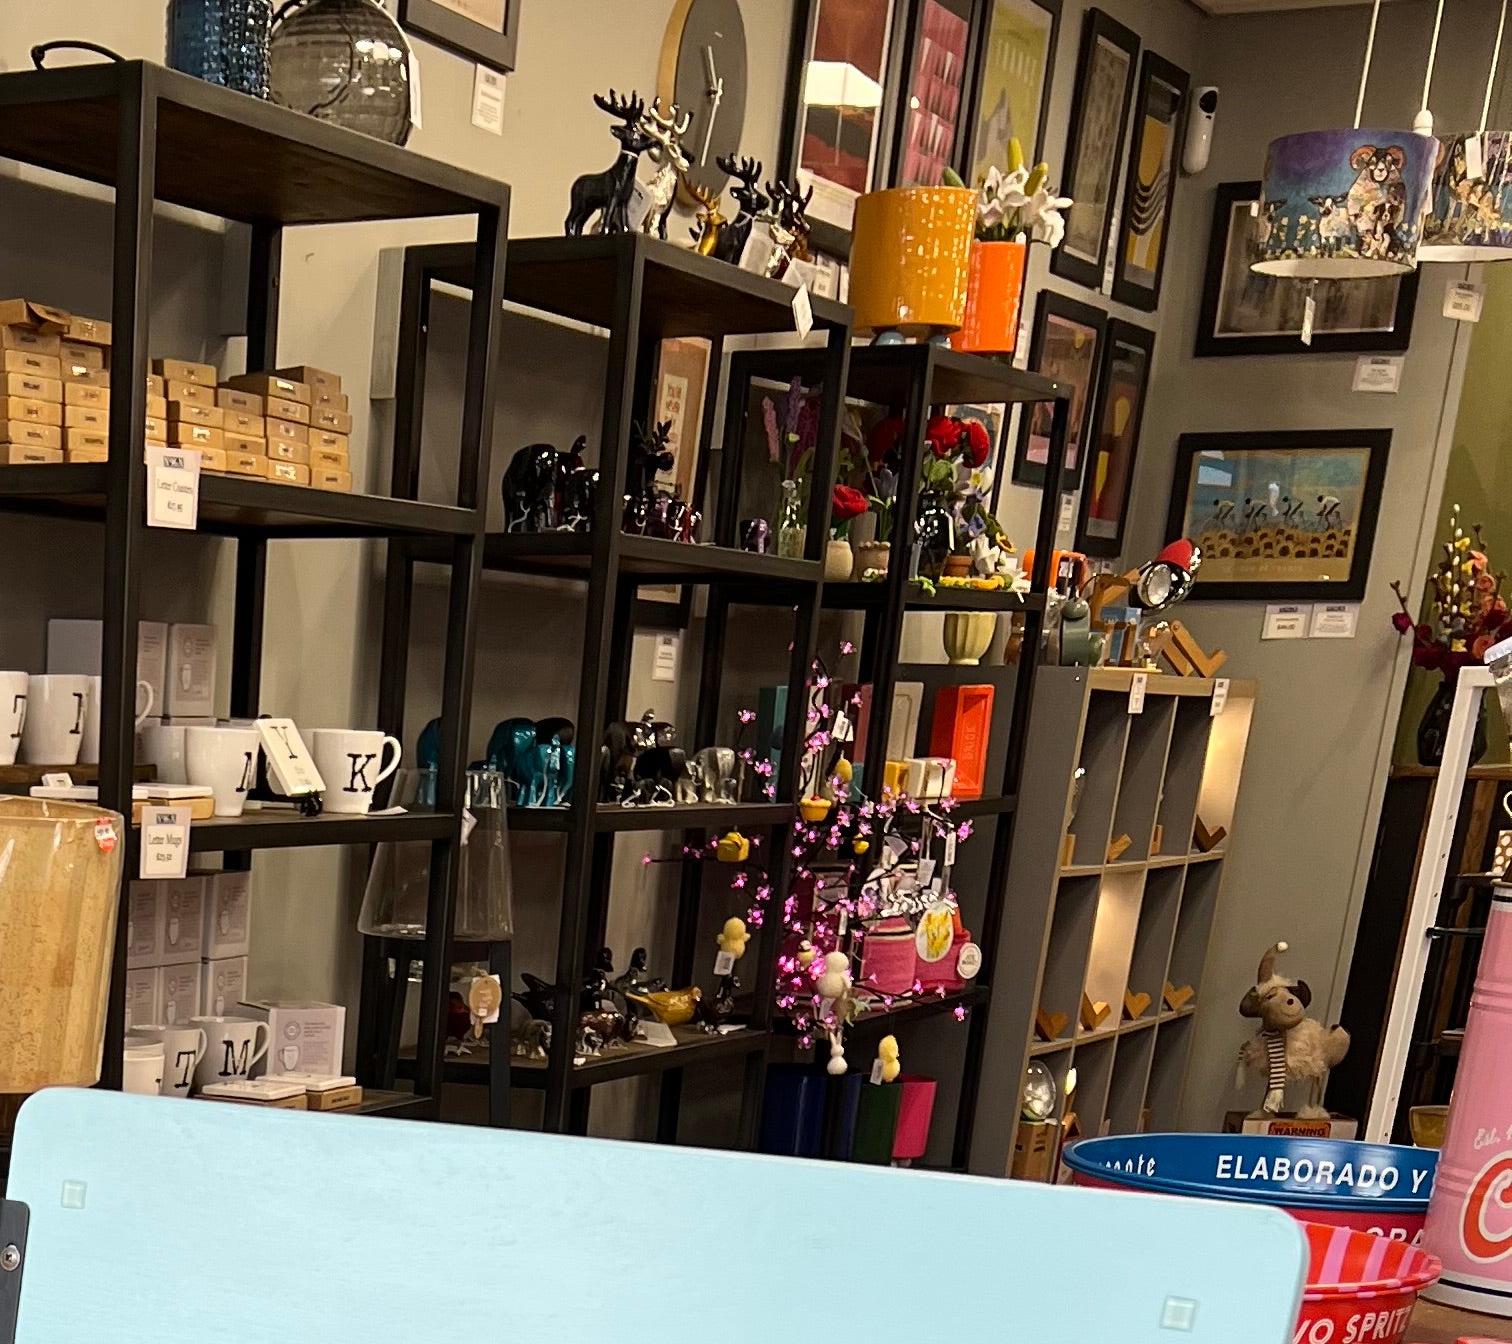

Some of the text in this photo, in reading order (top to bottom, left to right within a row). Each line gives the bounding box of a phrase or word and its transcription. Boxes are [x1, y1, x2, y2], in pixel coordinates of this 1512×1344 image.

[270, 725, 298, 759] Y
[342, 753, 377, 792] K
[218, 1039, 250, 1076] M
[1274, 1126, 1326, 1138] WARNING
[1216, 1154, 1428, 1194] ELABORADO Y
